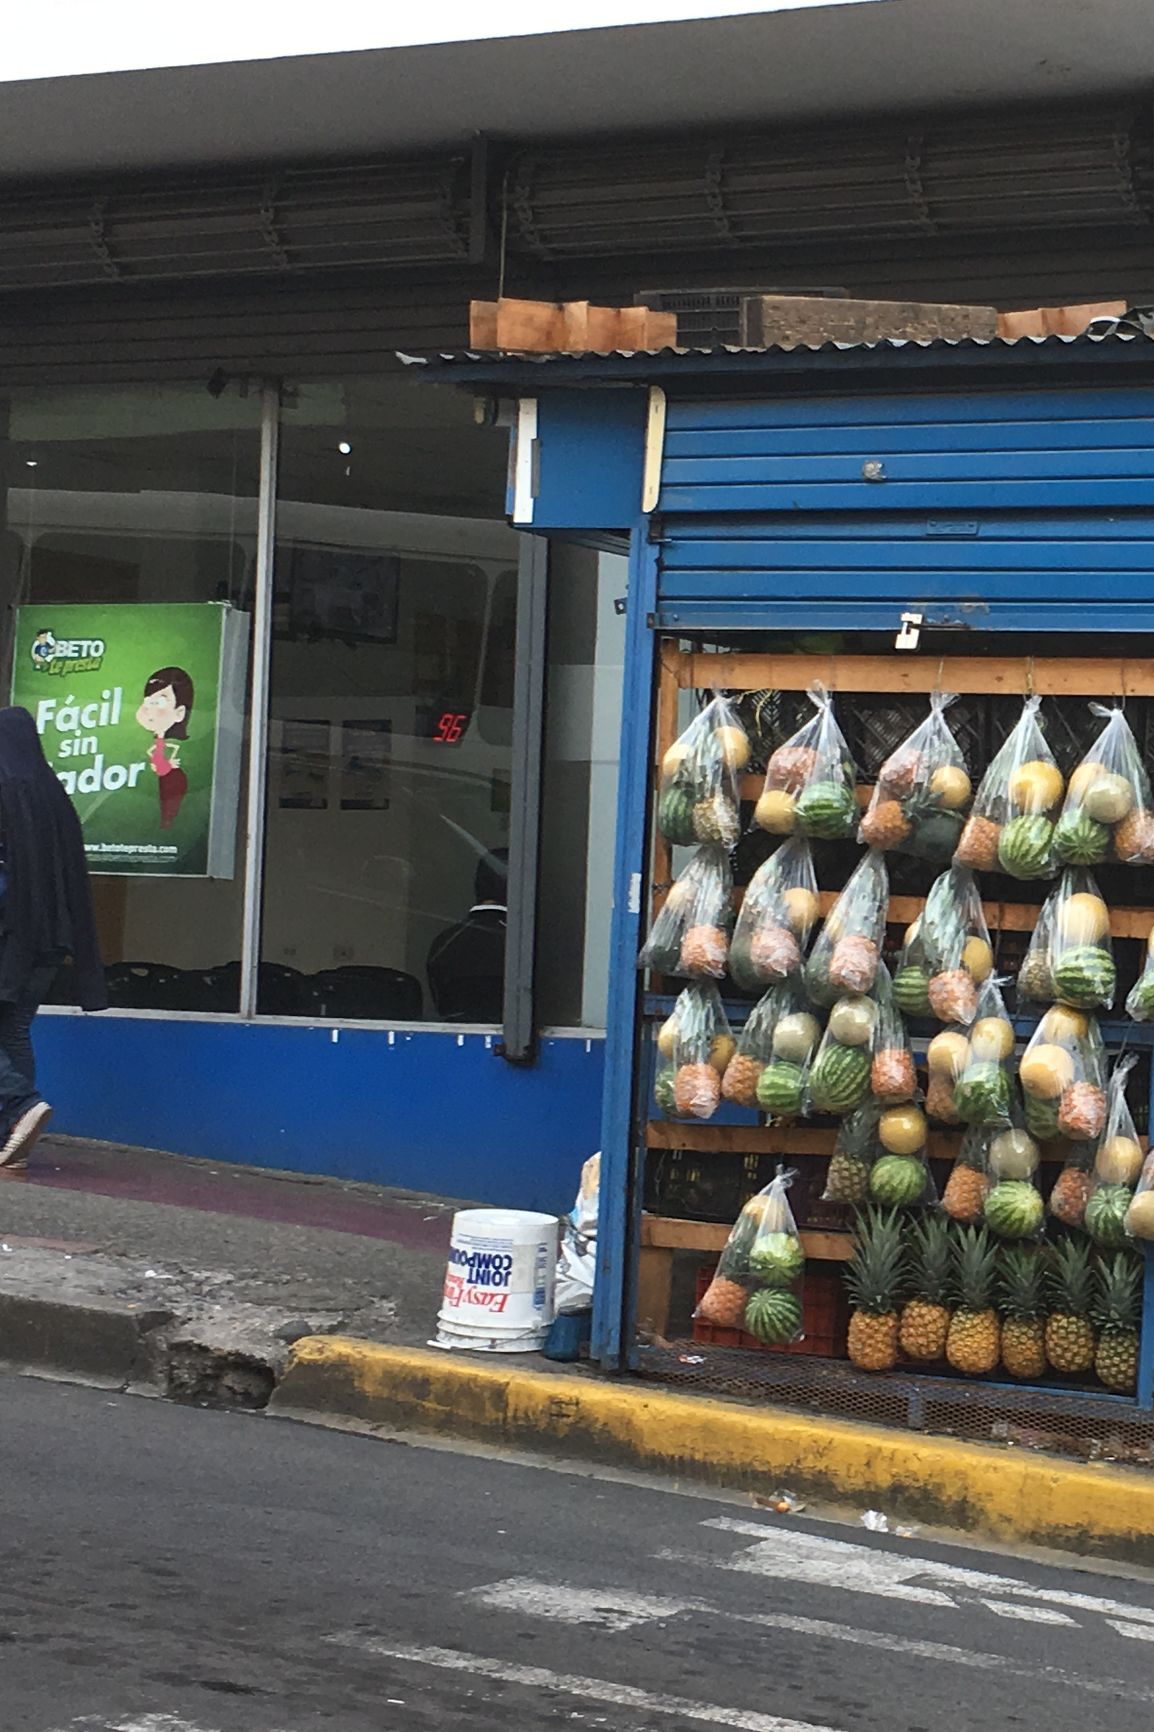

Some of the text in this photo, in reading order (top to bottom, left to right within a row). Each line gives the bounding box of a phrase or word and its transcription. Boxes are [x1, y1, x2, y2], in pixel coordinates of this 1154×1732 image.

[55, 640, 105, 658] BETO
[36, 687, 123, 735] Fácil
[58, 730, 98, 758] sin
[55, 754, 146, 796] ador
[466, 1267, 512, 1287] JOINT
